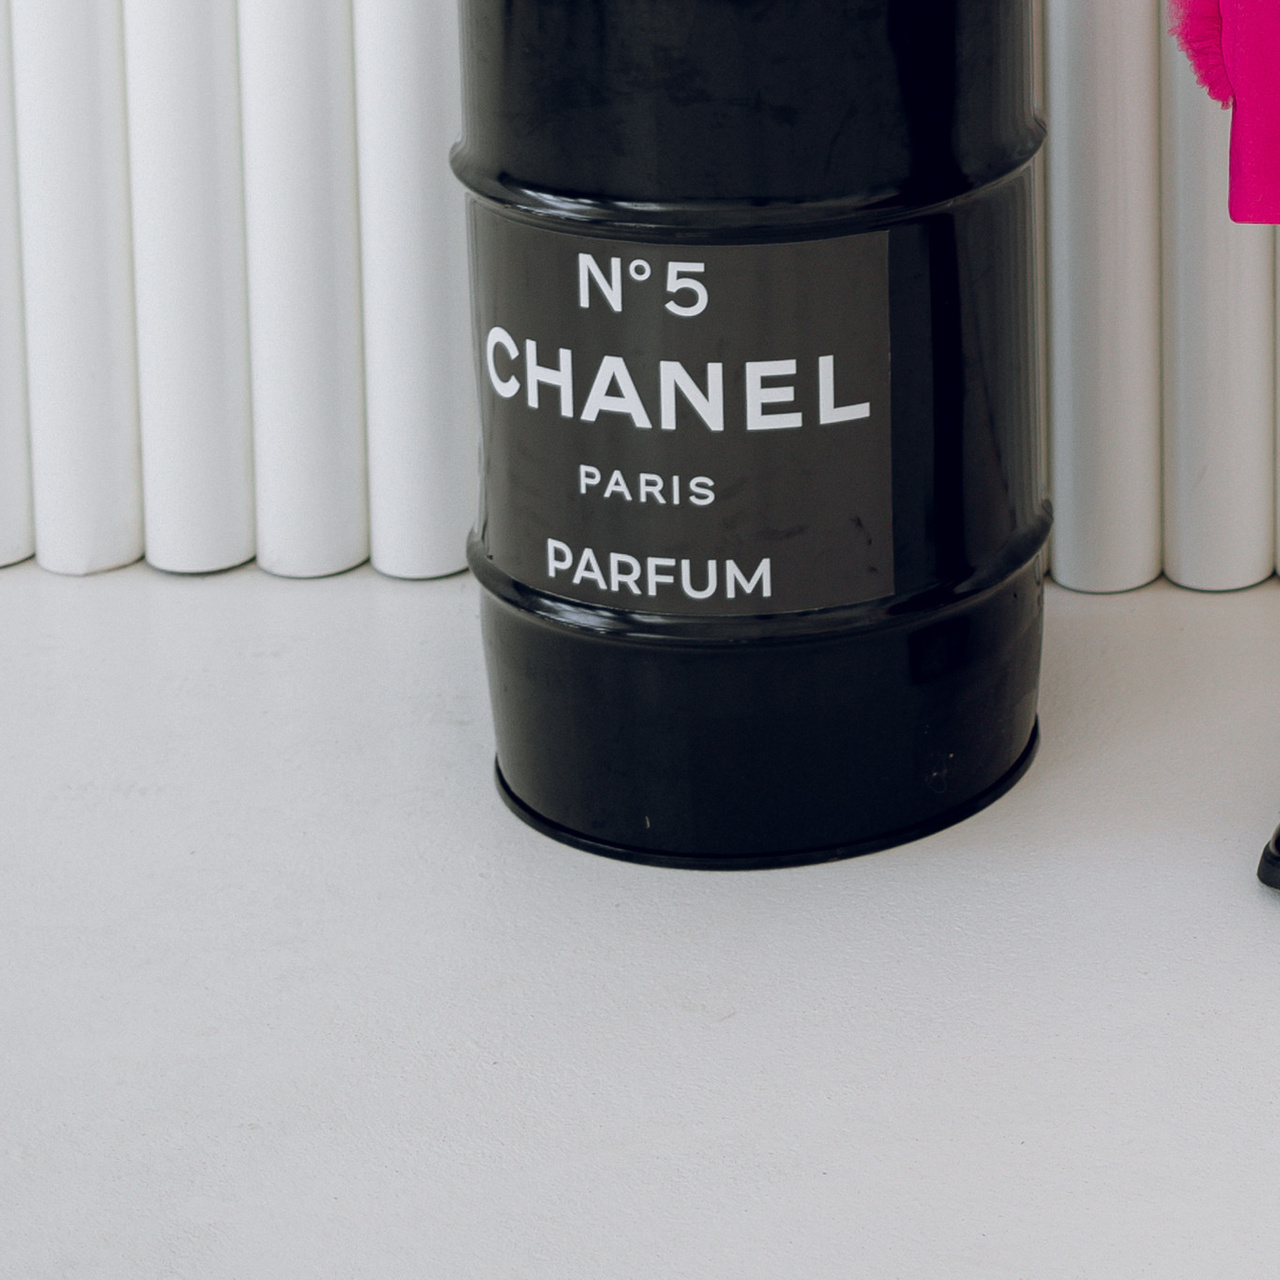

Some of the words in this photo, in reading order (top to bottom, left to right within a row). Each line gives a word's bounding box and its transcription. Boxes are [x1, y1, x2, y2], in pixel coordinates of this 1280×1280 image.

[486, 326, 871, 431] CHANEL
[579, 464, 716, 506] PARIS
[546, 537, 772, 599] PARFUM
